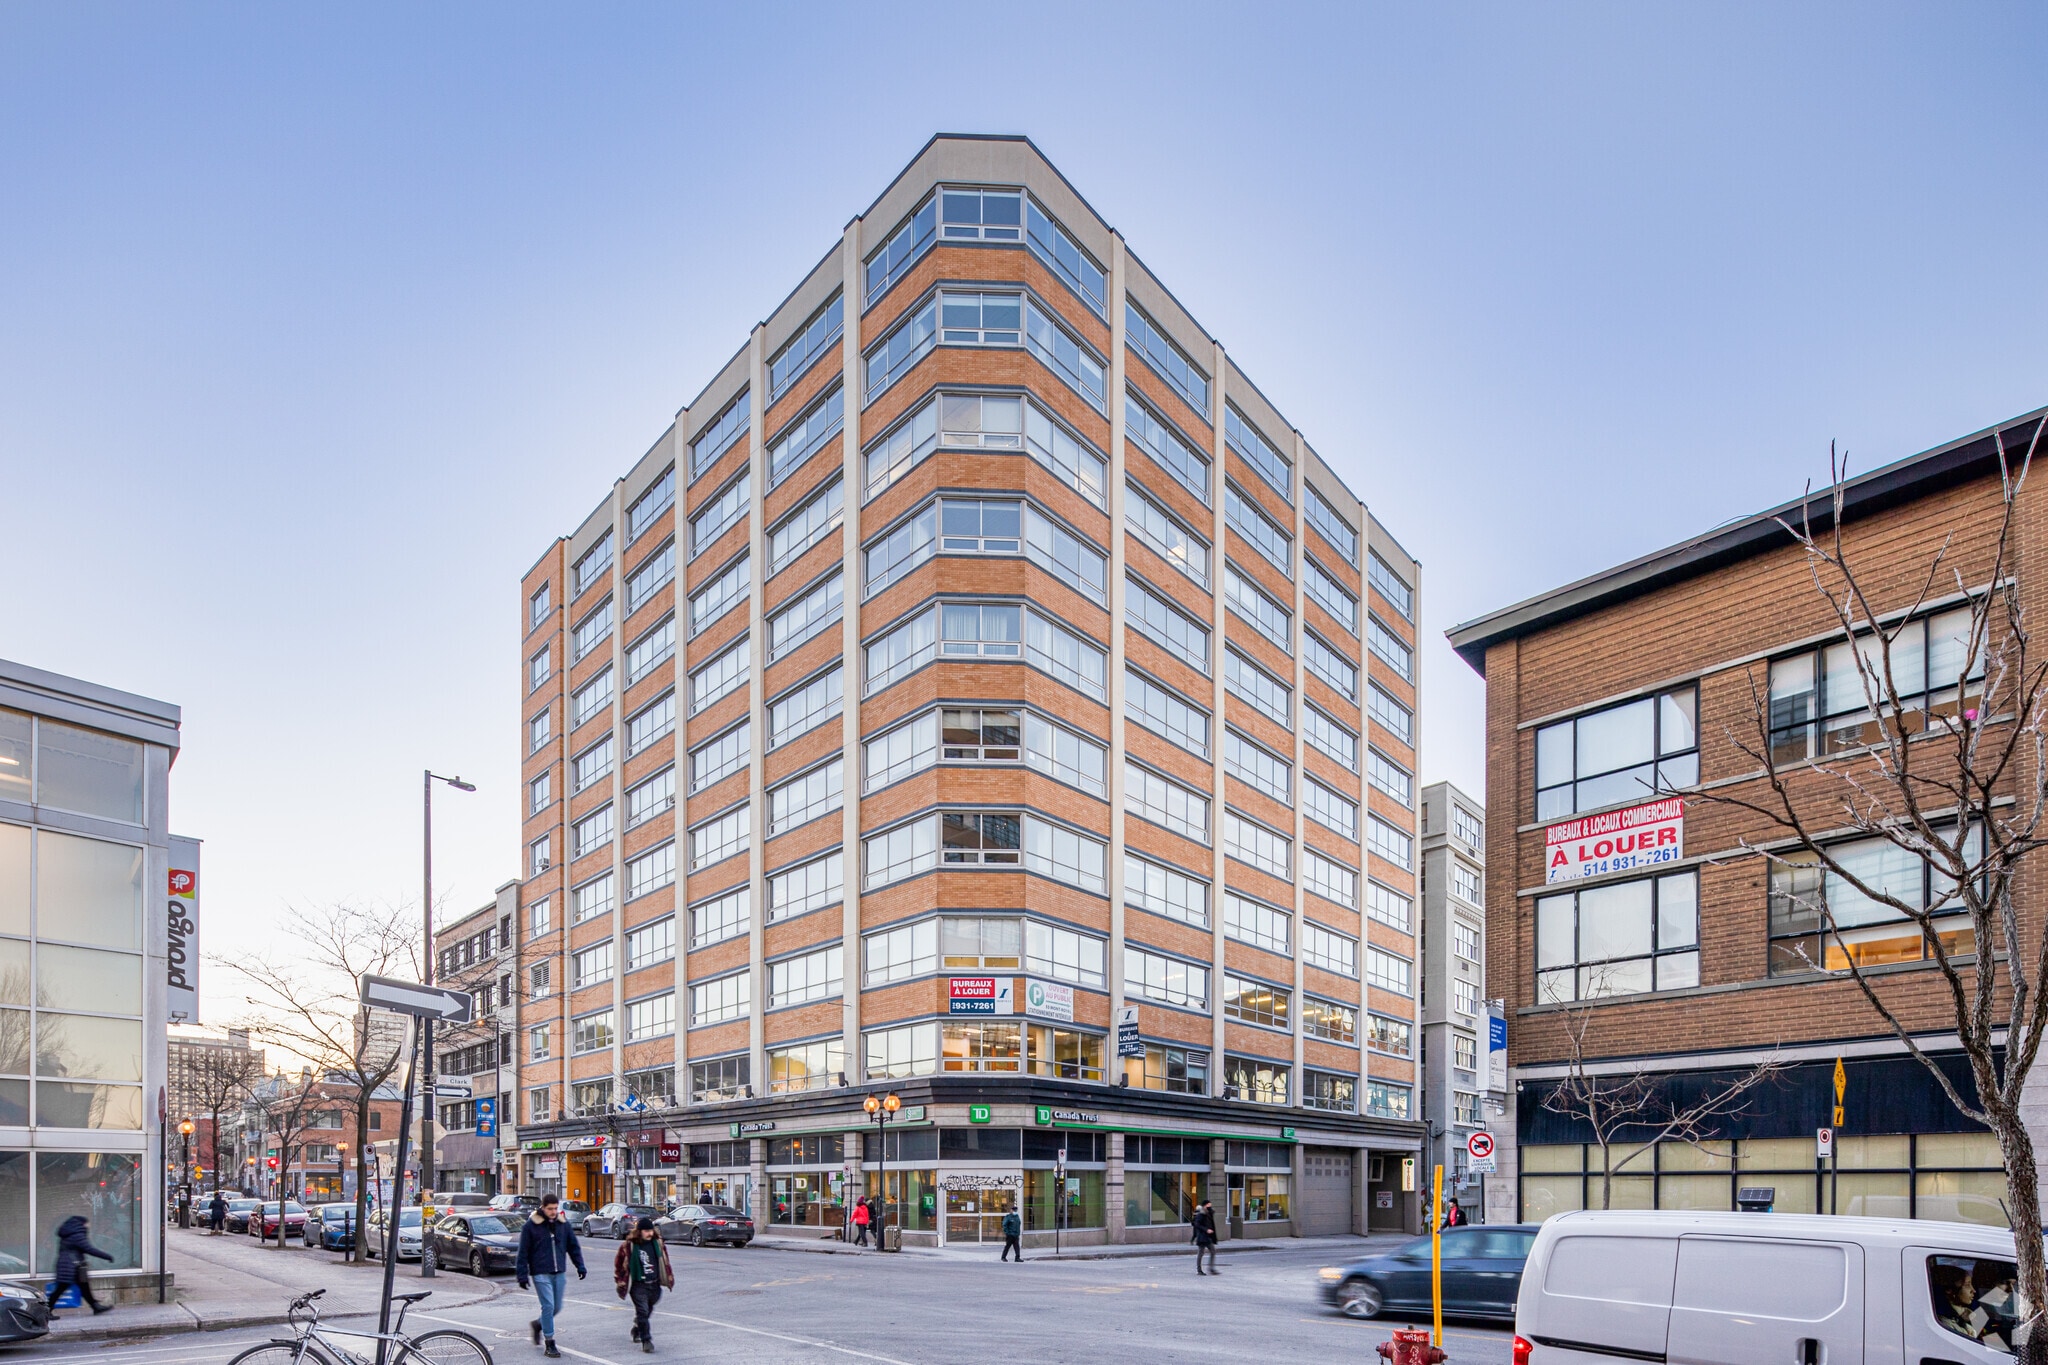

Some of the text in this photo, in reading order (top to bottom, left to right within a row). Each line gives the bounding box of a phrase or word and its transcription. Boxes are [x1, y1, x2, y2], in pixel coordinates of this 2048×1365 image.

[1547, 799, 1682, 844] BUREAUX & LOCAUX COMMERCIAUX
[1551, 826, 1677, 868] À LOUER
[1584, 860, 1608, 876] 514
[168, 900, 194, 992] provigo
[1048, 985, 1068, 994] OUVERT
[1054, 993, 1072, 1002] PUBLIC
[973, 1108, 988, 1119] TD
[1039, 1109, 1099, 1122] TD Canada Trust
[741, 1124, 758, 1132] Canada
[795, 1178, 808, 1189] TD
[924, 1196, 933, 1205] TD
